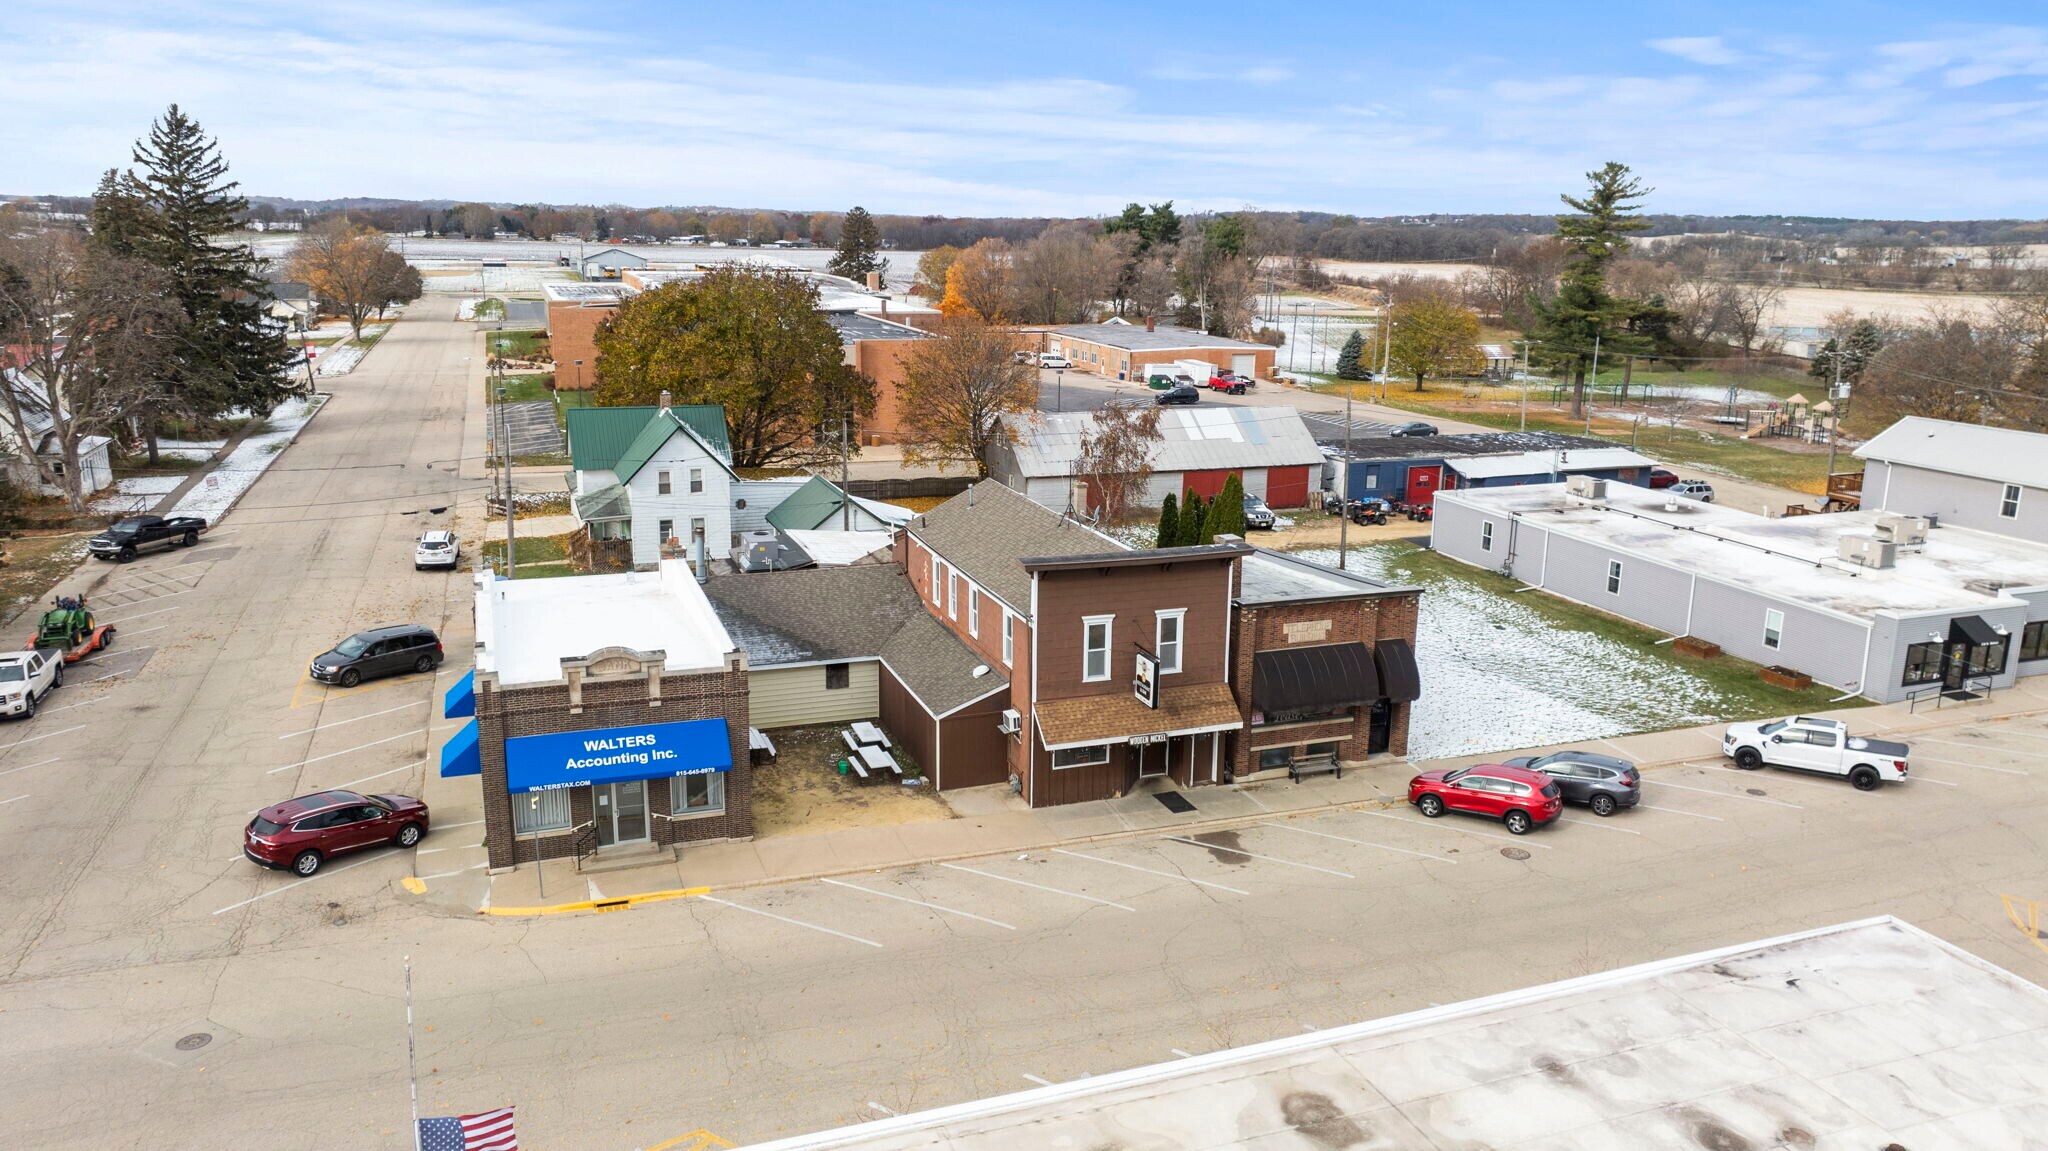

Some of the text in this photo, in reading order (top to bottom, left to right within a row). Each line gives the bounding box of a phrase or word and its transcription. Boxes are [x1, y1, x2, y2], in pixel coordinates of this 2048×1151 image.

[584, 734, 656, 751] WALTERS
[566, 748, 678, 769] Accounting Inc.
[529, 780, 591, 792] WALTERSTAX.COM
